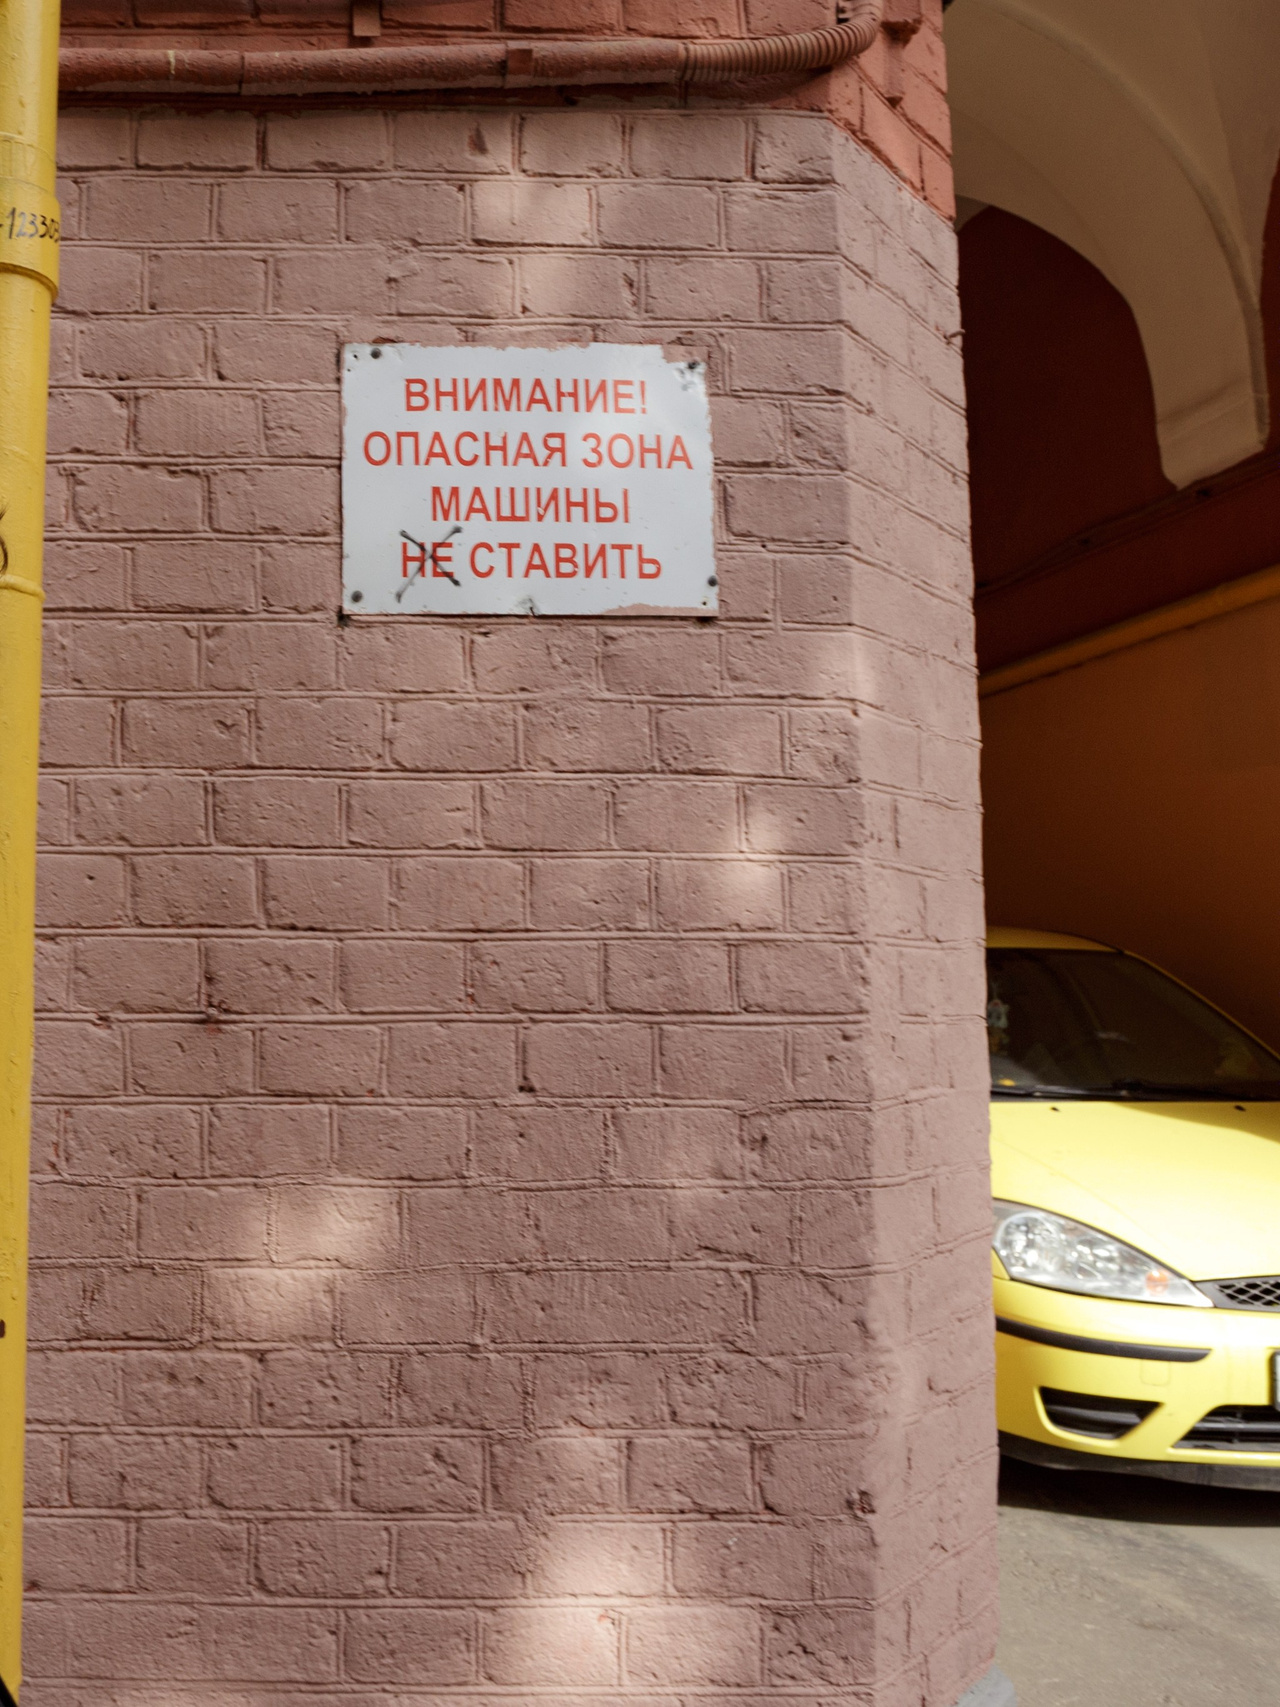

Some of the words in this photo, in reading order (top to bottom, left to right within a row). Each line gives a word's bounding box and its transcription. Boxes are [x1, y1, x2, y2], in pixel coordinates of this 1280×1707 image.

[405, 377, 647, 414] ВНИМАНИЕ!
[363, 431, 567, 467] ОПАСНАЯ
[581, 432, 694, 470] ЗОНА
[431, 486, 630, 523] МАШИНЫ
[401, 542, 455, 578] НЕ
[469, 542, 662, 580] СТАВИТЬ
